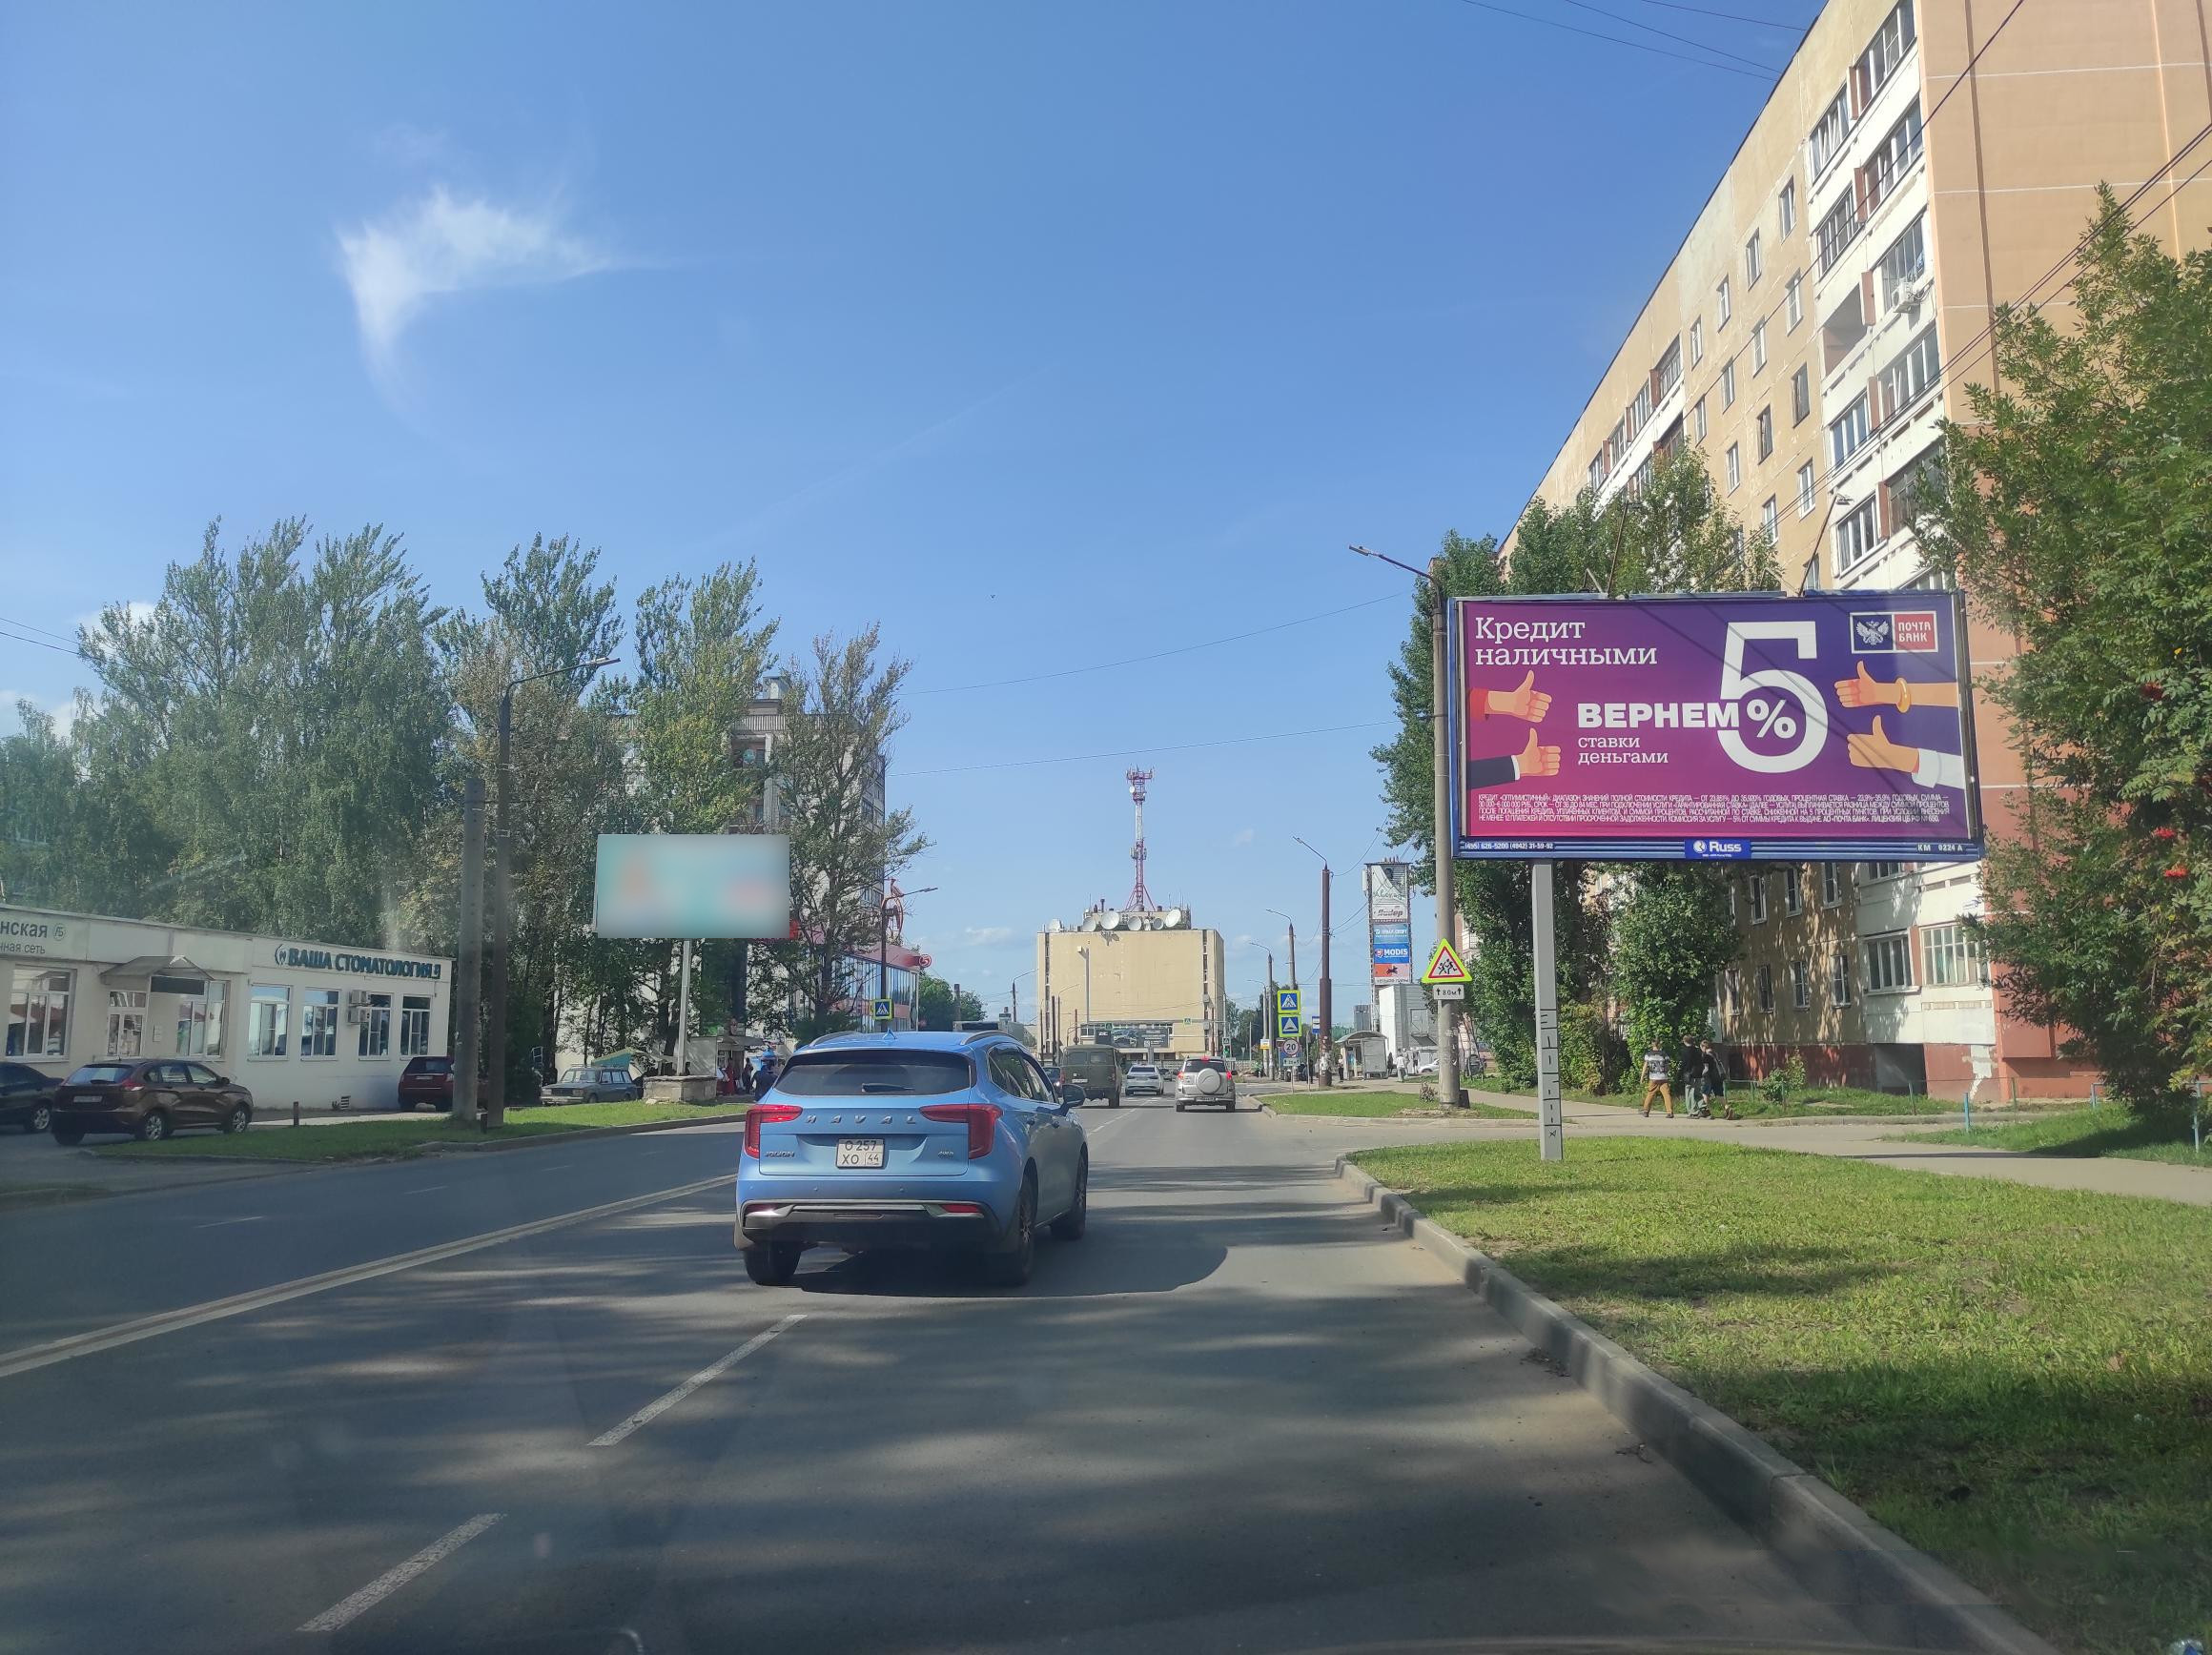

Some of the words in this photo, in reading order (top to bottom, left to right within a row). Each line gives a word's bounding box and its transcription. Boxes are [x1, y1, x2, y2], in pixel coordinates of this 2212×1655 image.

[1475, 617, 1586, 644] Кредит
[1897, 622, 1932, 632] ПОЧТА
[1898, 633, 1928, 643] БАНК
[1475, 647, 1657, 665] наличными
[1577, 702, 1740, 728] ВЕРНЕМ
[1578, 736, 1640, 748] ставки
[1578, 751, 1669, 766] деньгами
[24, 944, 46, 954] сеть
[288, 948, 333, 970] ВАША
[806, 1114, 916, 1125] HAVAL
[857, 1140, 877, 1152] 257
[867, 1154, 880, 1162] 44
